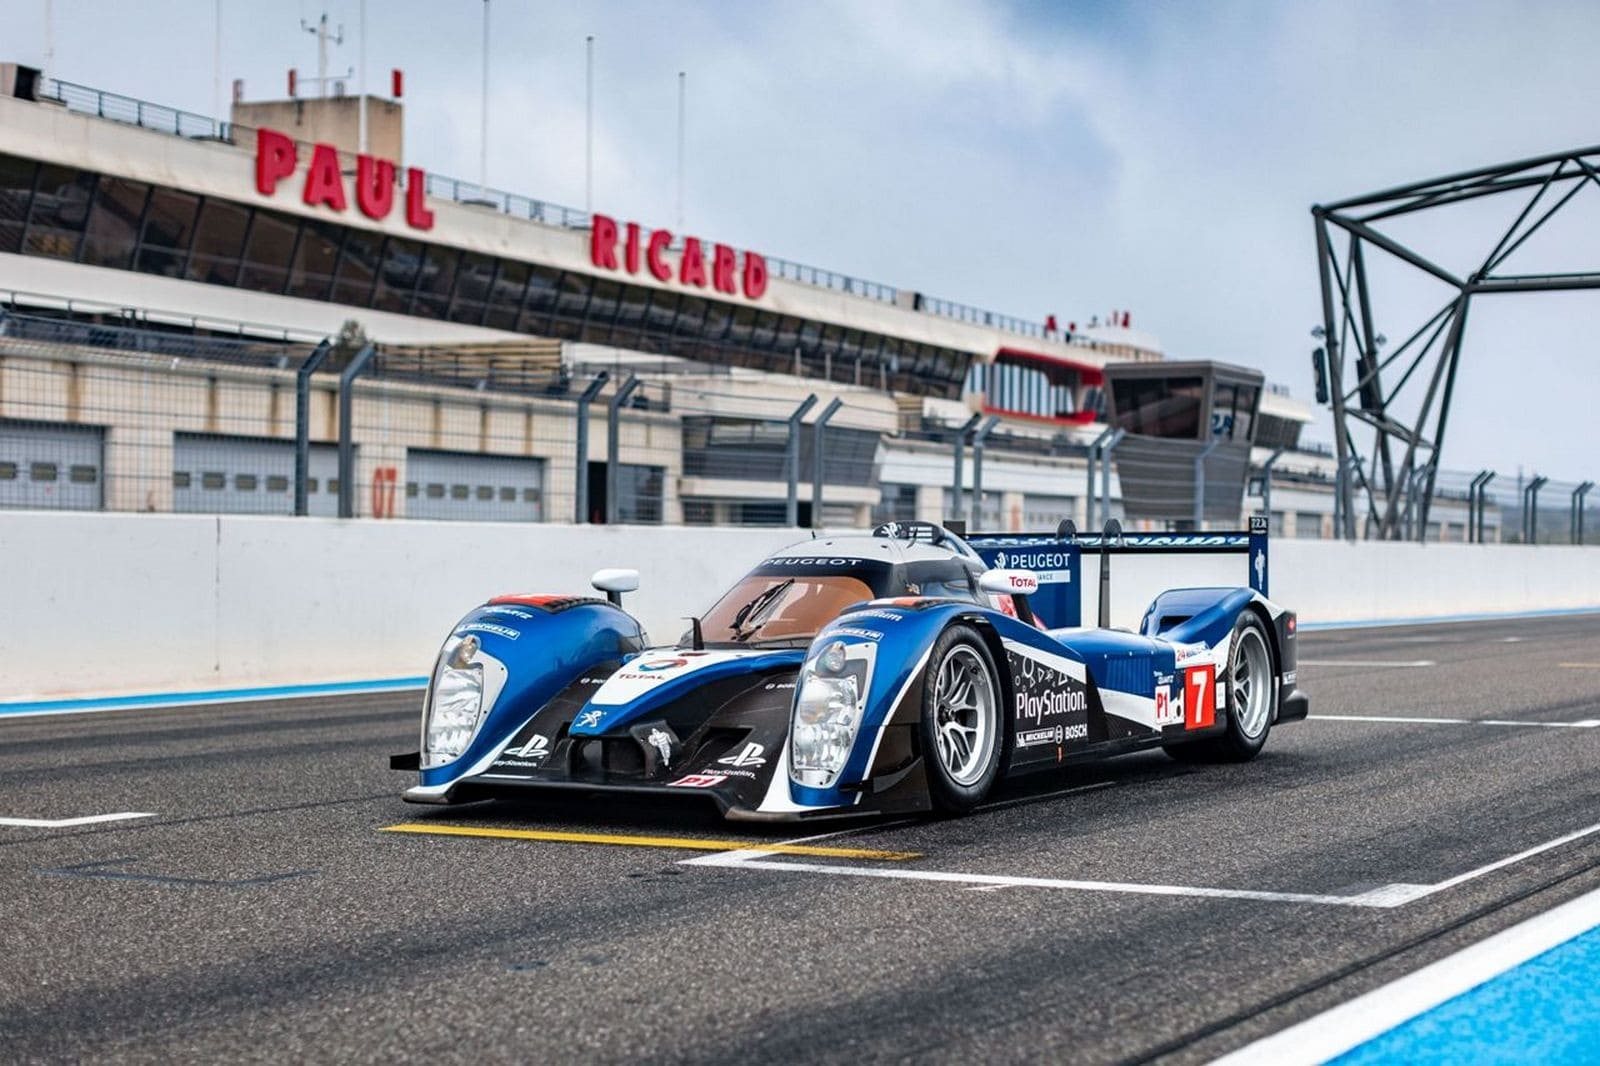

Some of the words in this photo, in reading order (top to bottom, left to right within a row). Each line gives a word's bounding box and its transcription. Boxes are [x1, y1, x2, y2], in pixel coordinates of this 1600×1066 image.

[256, 127, 434, 231] PAUL
[591, 214, 767, 299] RICARD
[763, 558, 862, 566] PEUGEOT
[1011, 553, 1070, 568] PEUGEOT
[1009, 576, 1037, 588] TOTAL
[618, 673, 665, 681] TOTAL
[1191, 670, 1209, 724] 7
[1156, 692, 1169, 719] P1
[1026, 731, 1054, 742] MICHELIN
[1065, 723, 1088, 740] BOSCH
[677, 777, 719, 786] P1
